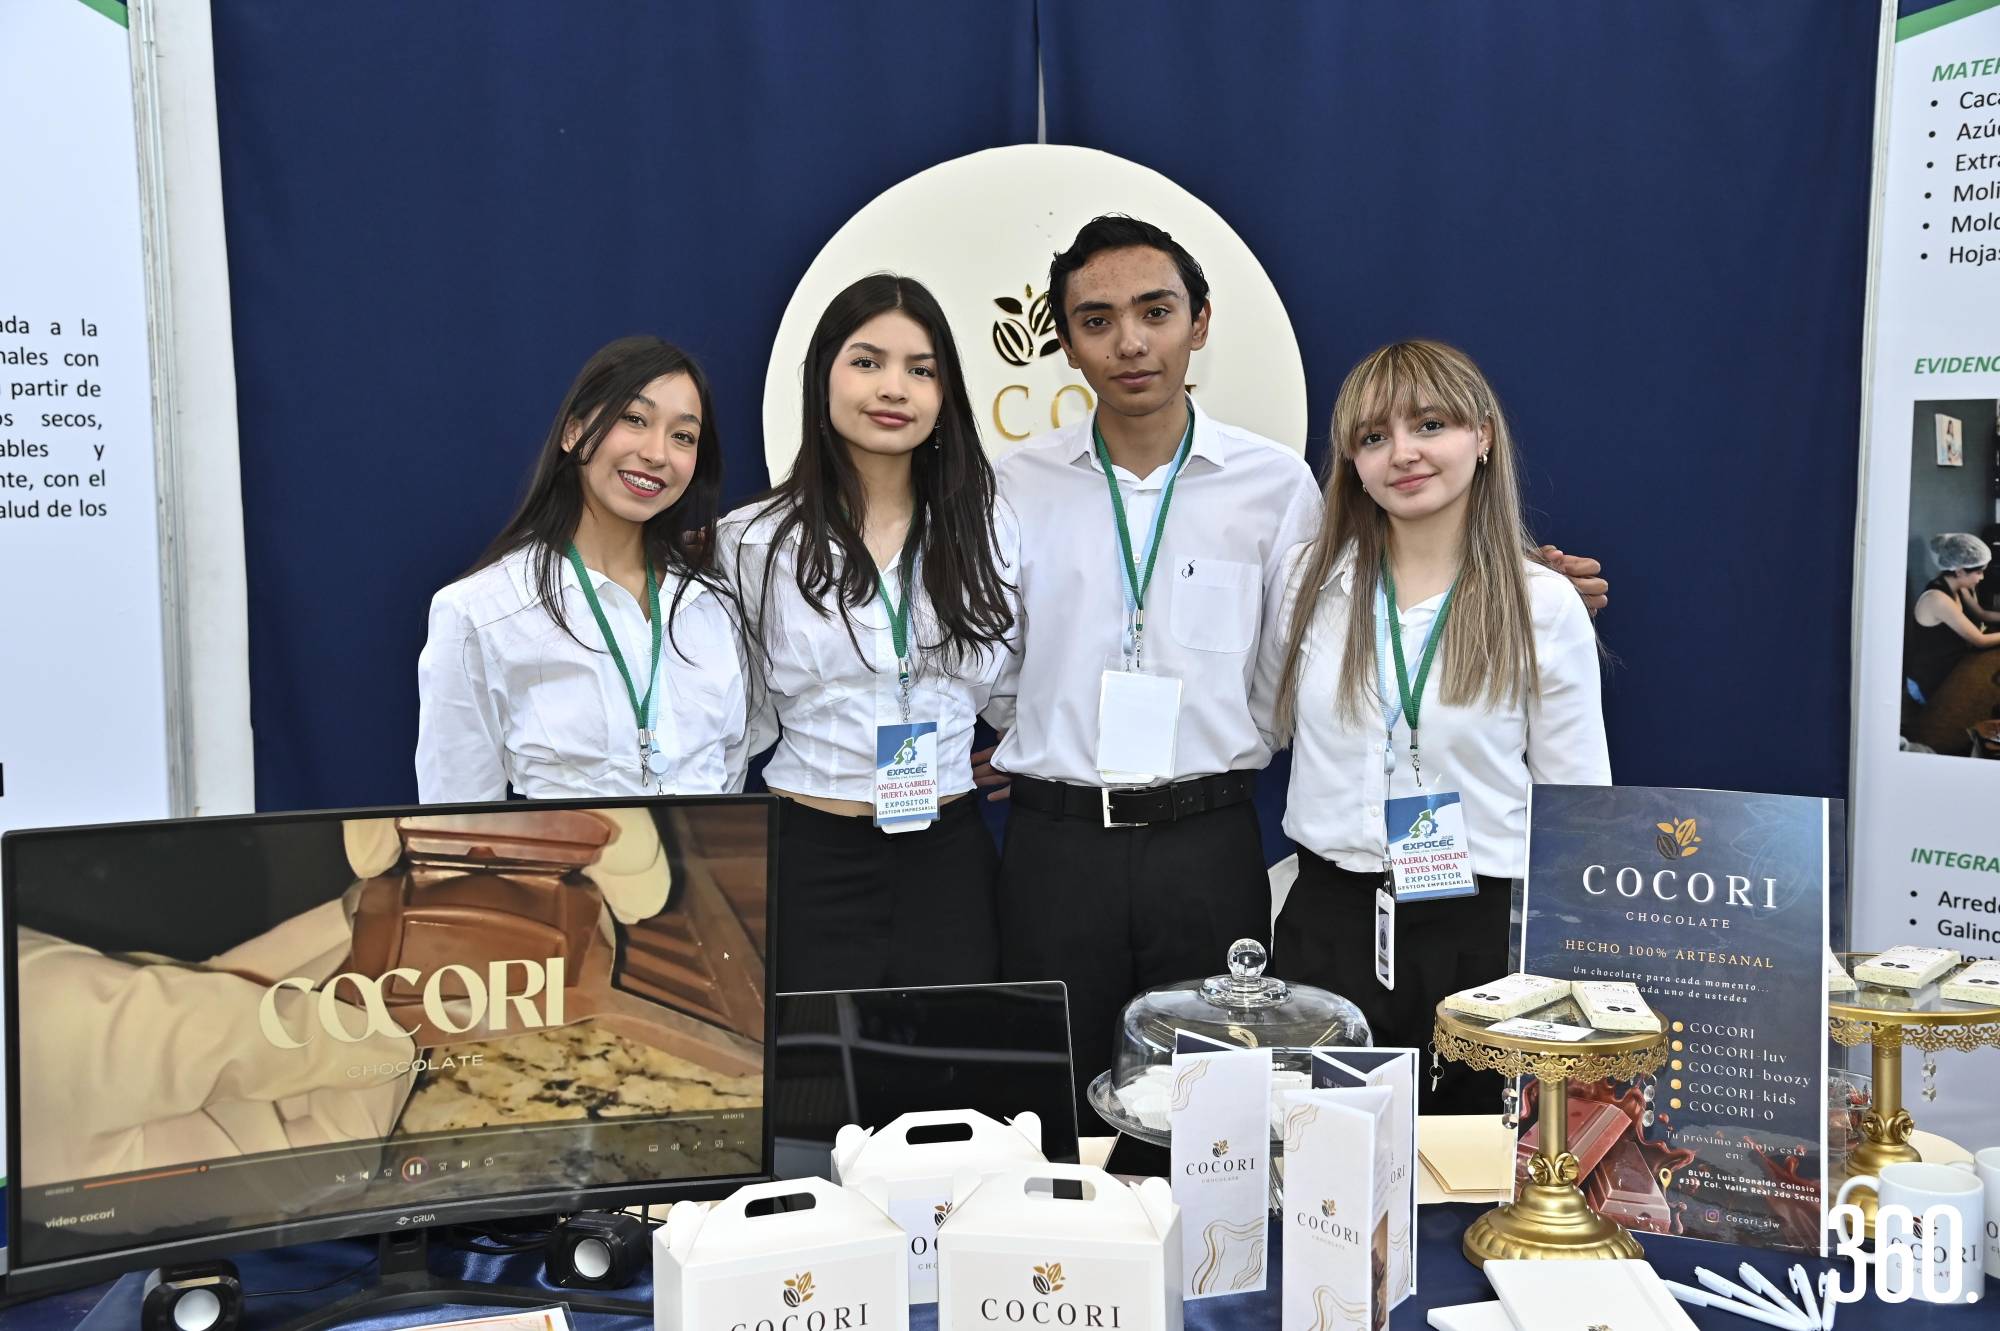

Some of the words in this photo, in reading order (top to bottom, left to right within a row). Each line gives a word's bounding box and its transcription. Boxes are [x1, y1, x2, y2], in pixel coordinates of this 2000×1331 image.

[1960, 91, 2000, 110] Cac
[1956, 118, 2000, 141] Azú
[1956, 153, 2000, 172] Extr
[1949, 244, 2000, 267] Hoja
[50, 321, 61, 335] a
[81, 318, 98, 337] la
[64, 352, 99, 367] con
[11, 379, 68, 400] partir
[76, 379, 101, 397] de
[41, 412, 103, 431] secos,
[93, 444, 105, 461] y
[43, 474, 79, 488] con
[89, 469, 106, 487] el
[47, 499, 72, 517] de
[79, 499, 107, 518] los
[887, 767, 927, 776] EXPOTEC
[881, 791, 907, 799] HUERTA
[909, 788, 933, 797] RAMOS
[885, 799, 929, 808] EXPOSITOR
[1403, 839, 1454, 850] EXPOTEC
[1391, 856, 1429, 866] VALERIA
[1430, 851, 1469, 863] JOSELINE
[1404, 865, 1431, 875] REYES
[1432, 863, 1459, 872] MORA
[1405, 871, 1462, 884] EXPOSITOR
[1582, 864, 1777, 909] COCORI
[1938, 890, 2000, 914] Arred
[1625, 911, 1731, 929] CHOCOLATE
[1565, 939, 1621, 955] HECHO
[1628, 944, 1668, 959] 100%
[1675, 949, 1775, 969] ARTESANAL
[1573, 965, 1587, 975] Un
[1590, 968, 1642, 981] chocolate
[1646, 974, 1671, 983] para
[1675, 976, 1701, 986] cada
[259, 957, 565, 1049] COCORI
[1637, 985, 1660, 995] ada
[1664, 989, 1684, 998] uno
[1688, 989, 1700, 999] de
[1705, 992, 1748, 1004] ustedes
[1689, 1022, 1754, 1040] COCORI
[346, 1054, 485, 1079] CHOCOLATE
[1665, 1130, 1679, 1140] Tu
[1186, 1158, 1255, 1176] COCORI
[1688, 1169, 1714, 1180] BLVD.
[1717, 1173, 1736, 1183] Luis
[1739, 1176, 1777, 1188] Donaldo
[1780, 1182, 1815, 1193] Colosio
[1704, 1180, 1721, 1189] Col.
[1725, 1183, 1748, 1193] Valle
[1751, 1187, 1771, 1197] Real
[1774, 1190, 1791, 1199] 2do
[45, 1216, 78, 1229] video
[412, 1213, 436, 1223] CRUA
[1297, 1211, 1359, 1245] COCORI
[1890, 1236, 1977, 1264] CORI
[981, 1298, 1121, 1329] COCORI
